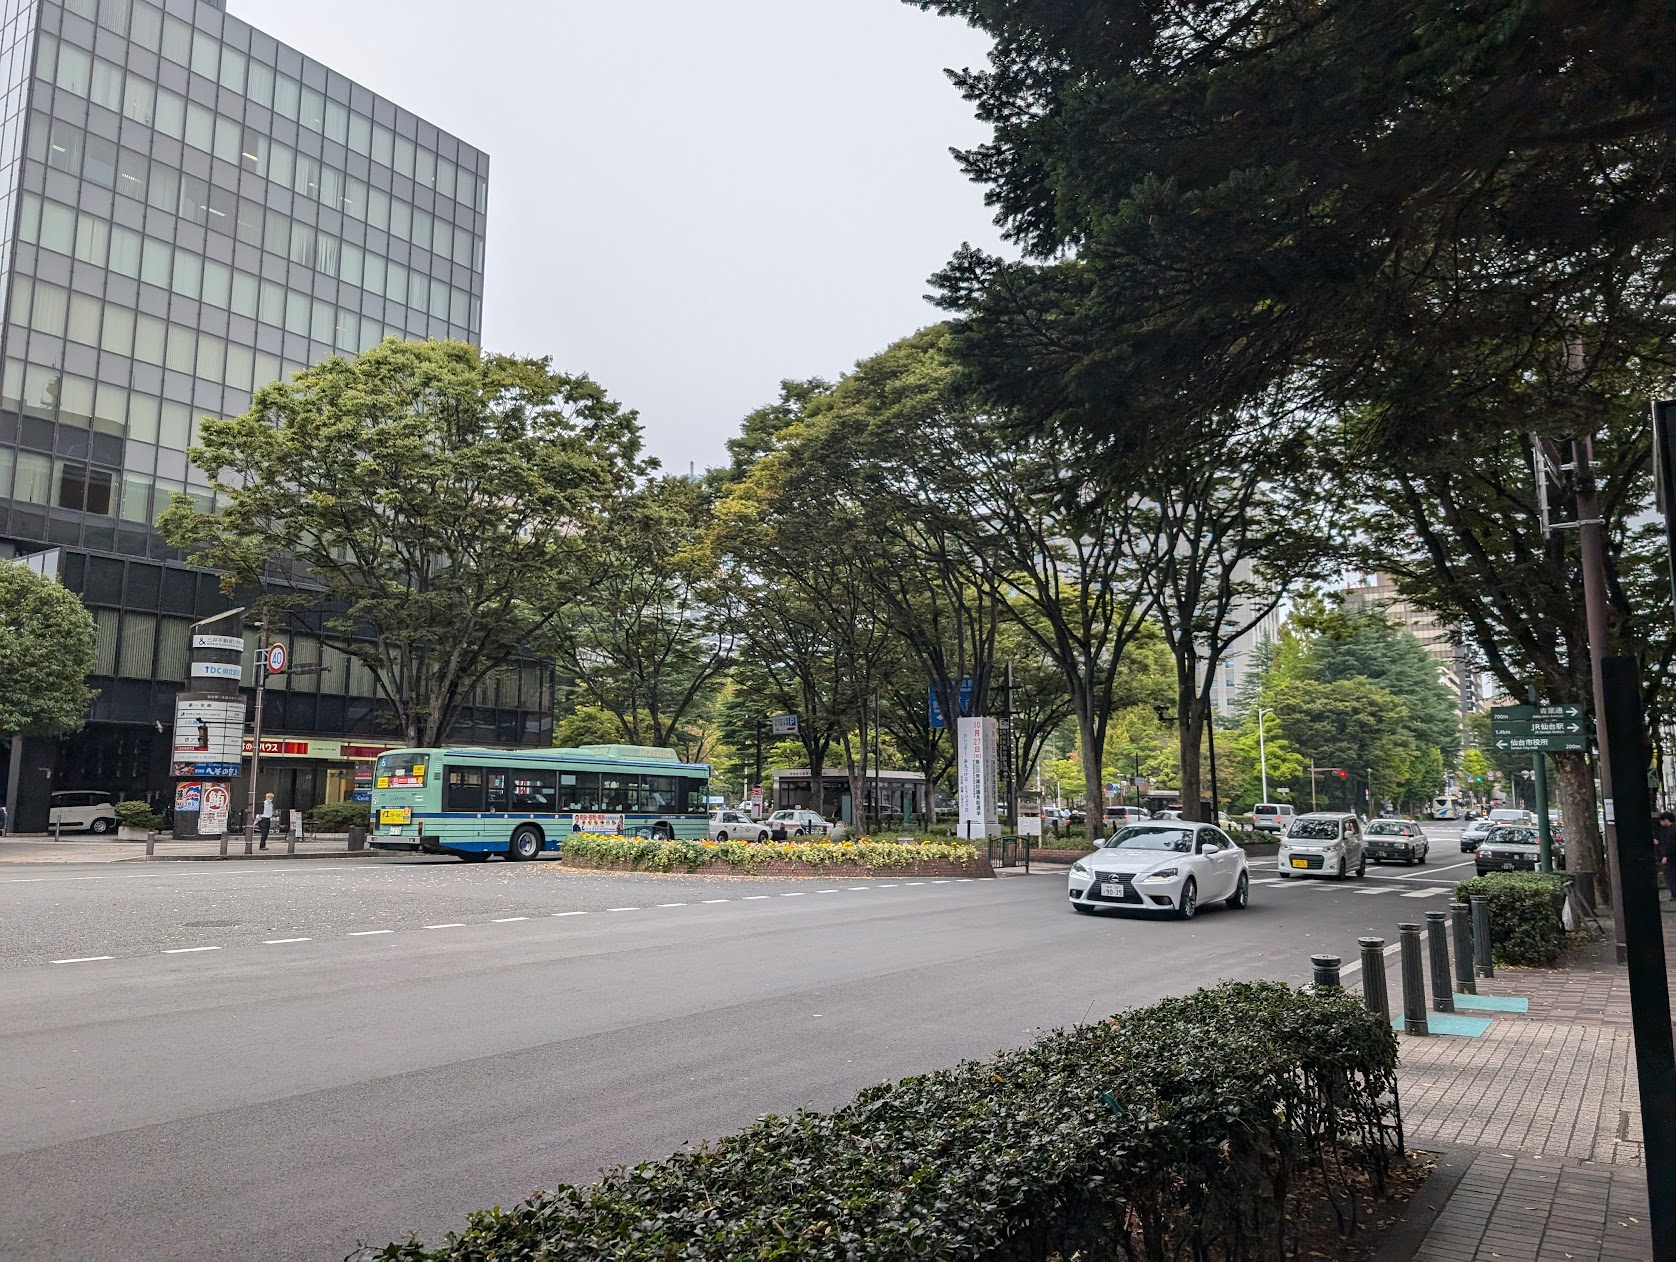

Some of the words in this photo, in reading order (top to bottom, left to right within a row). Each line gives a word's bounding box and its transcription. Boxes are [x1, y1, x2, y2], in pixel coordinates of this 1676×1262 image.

[272, 652, 282, 664] 40
[204, 666, 221, 674] tbc
[1531, 723, 1564, 731] JR仙台駅
